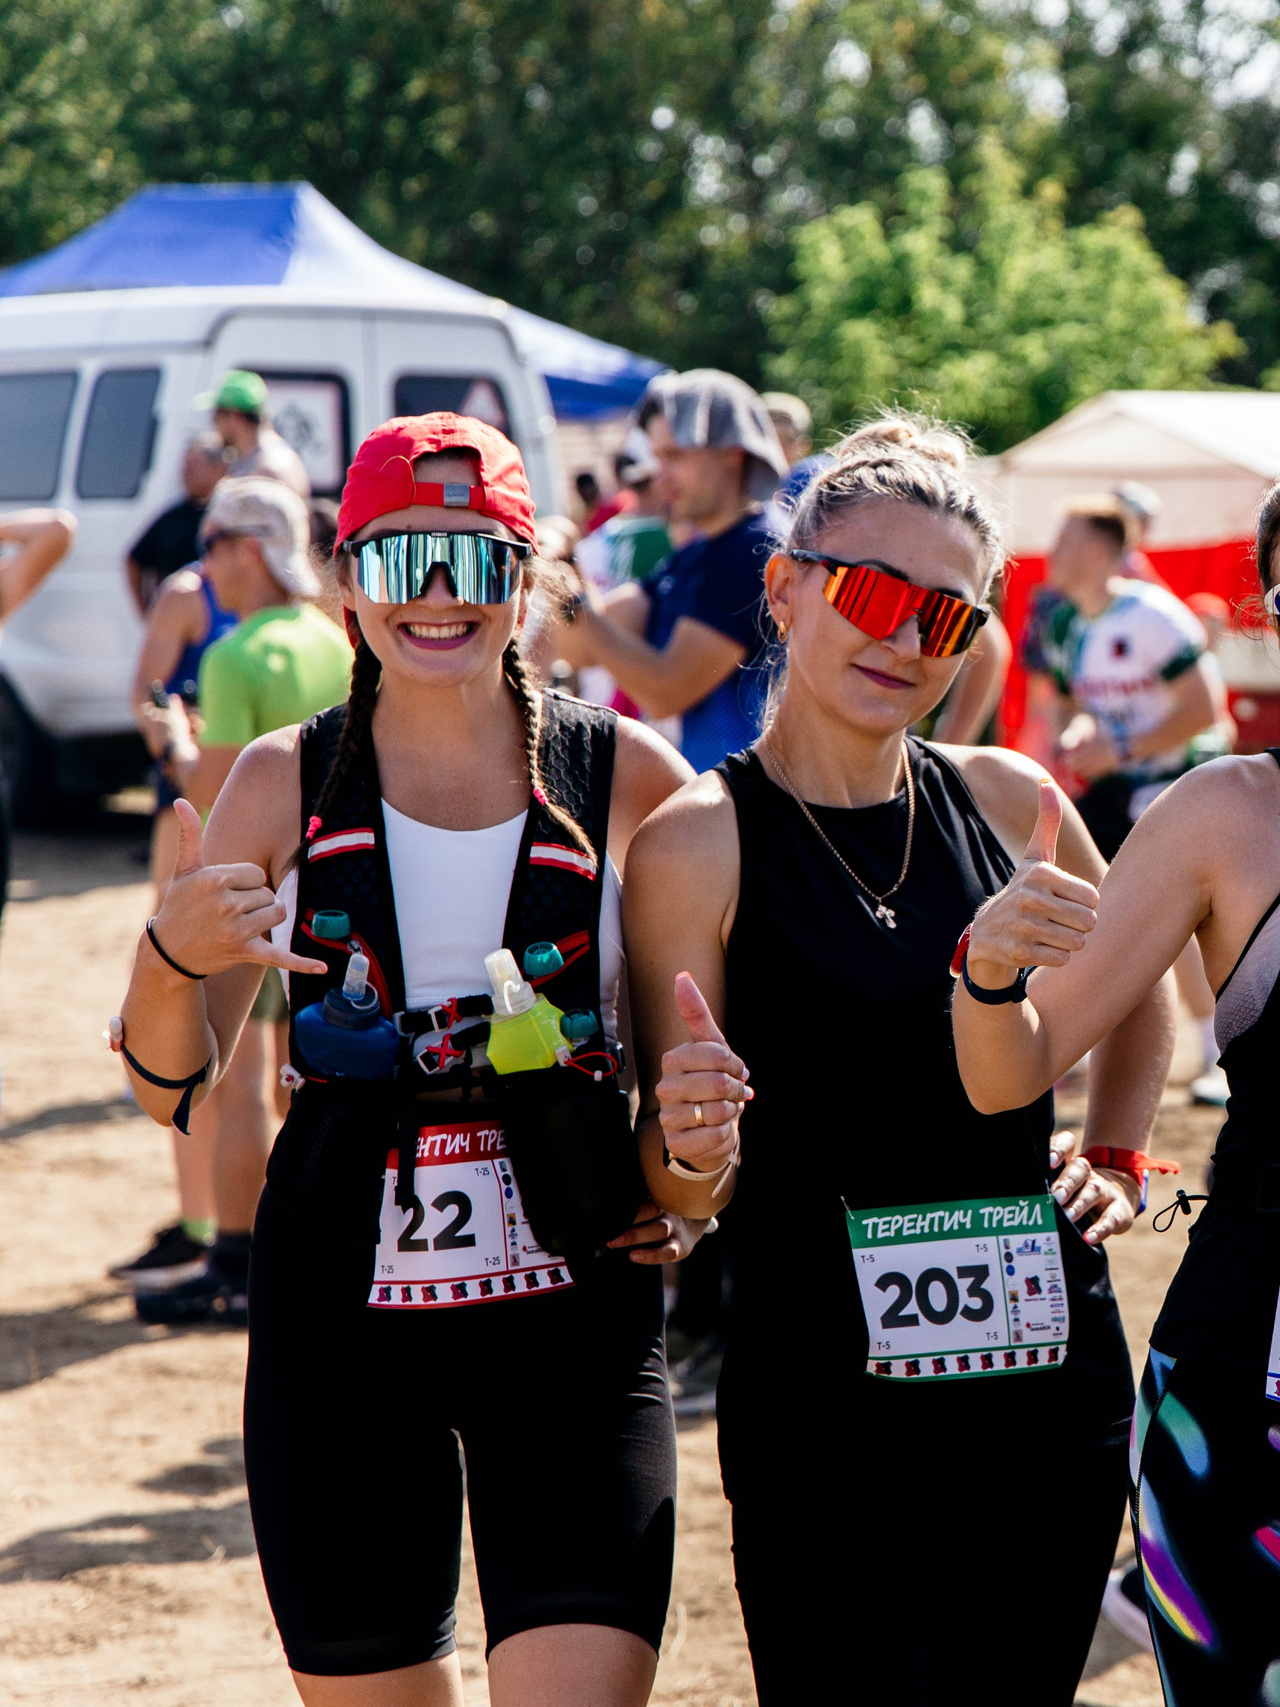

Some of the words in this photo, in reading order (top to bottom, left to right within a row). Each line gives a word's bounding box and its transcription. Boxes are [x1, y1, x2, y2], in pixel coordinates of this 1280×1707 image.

[397, 1190, 476, 1252] 22
[862, 1209, 972, 1240] ТЕРЕНТИЧ
[979, 1200, 1043, 1229] ТРЕЙЛ
[874, 1264, 994, 1330] 203
